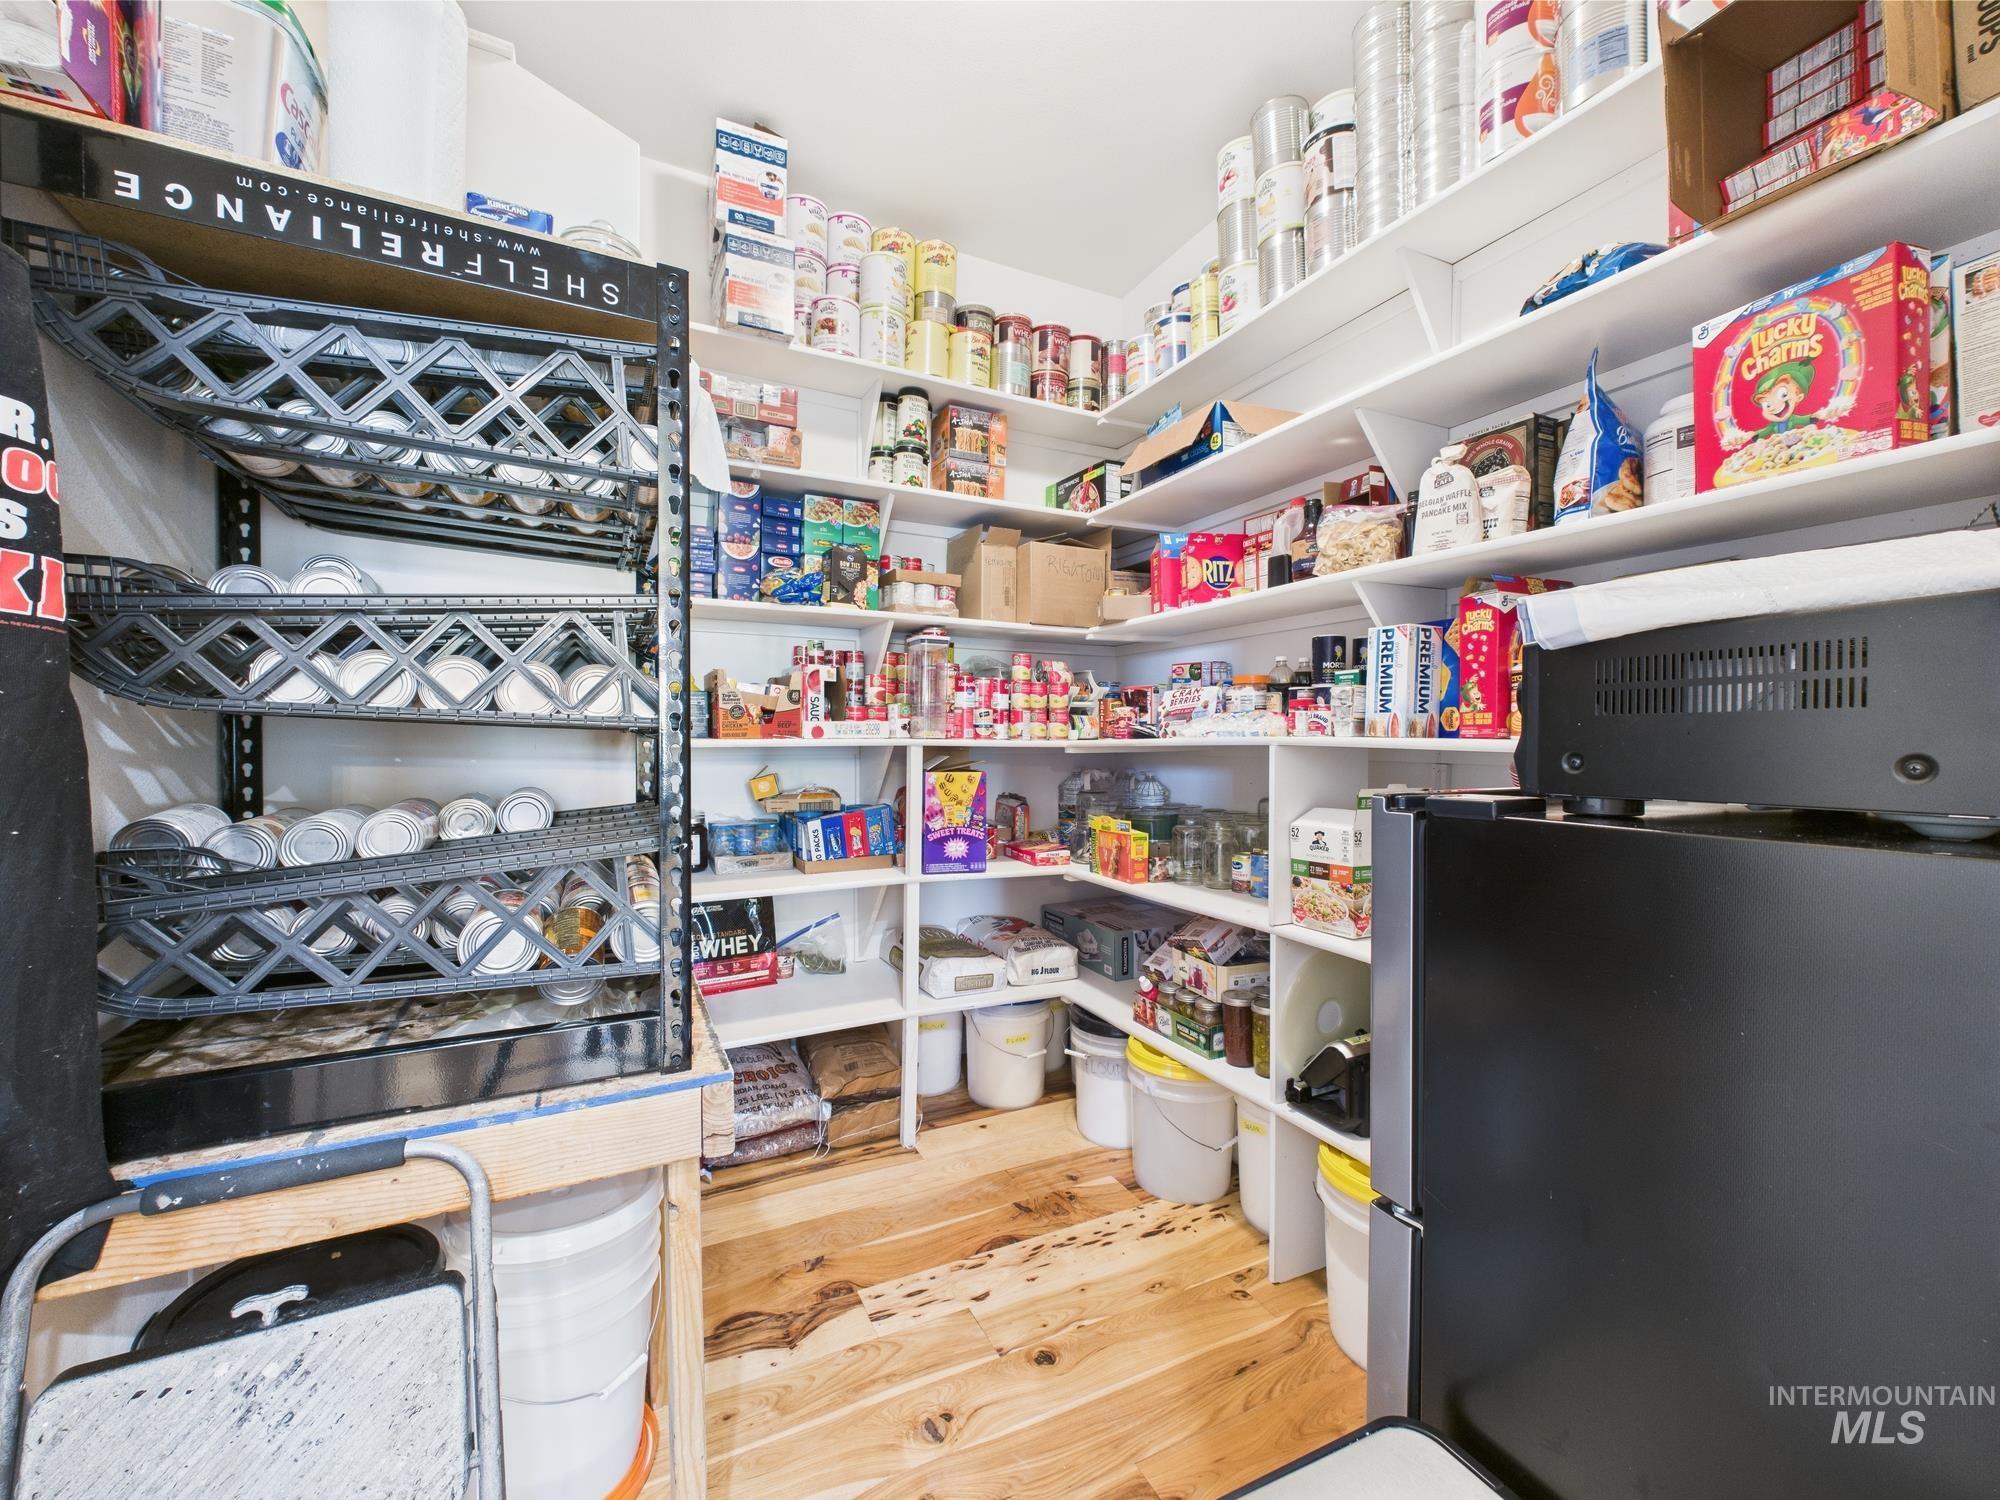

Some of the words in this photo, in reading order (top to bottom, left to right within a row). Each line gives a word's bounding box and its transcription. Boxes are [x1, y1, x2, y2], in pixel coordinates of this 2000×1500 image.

[236, 175, 541, 257] www.shelfreliance.com
[487, 199, 529, 217] KIRKLAND
[1902, 265, 1927, 288] Lucky
[1898, 281, 1929, 305] Charms
[1751, 313, 1818, 357] Lucky
[1741, 333, 1824, 381] Charms
[1042, 382, 1066, 394] WHEAT
[1495, 438, 1515, 450] GRAINS
[1419, 496, 1445, 510] BELGIAN
[1445, 488, 1473, 503] WAFFLE
[1421, 504, 1452, 520] PANCAKE
[1452, 502, 1468, 514] MIX
[1202, 558, 1235, 584] RITZ
[1464, 608, 1493, 625] Lucky
[1461, 619, 1495, 636] Charms
[1379, 627, 1395, 714] PREMIUM
[1418, 627, 1432, 714] PREMIUM
[1170, 694, 1201, 707] BERRIES
[812, 828, 821, 853] PACKS
[926, 827, 955, 842] SWEET
[956, 827, 985, 840] TREATS
[1291, 827, 1300, 838] 52
[1354, 831, 1362, 843] 52
[1309, 844, 1330, 853] QUAKER
[699, 933, 763, 959] WHEY
[1044, 966, 1060, 975] FLOUR
[745, 1053, 774, 1064] CLEAN
[733, 1062, 798, 1085] CHOICE
[762, 1082, 788, 1091] IDAHO
[737, 1097, 749, 1106] 25
[751, 1093, 773, 1103] LBS.
